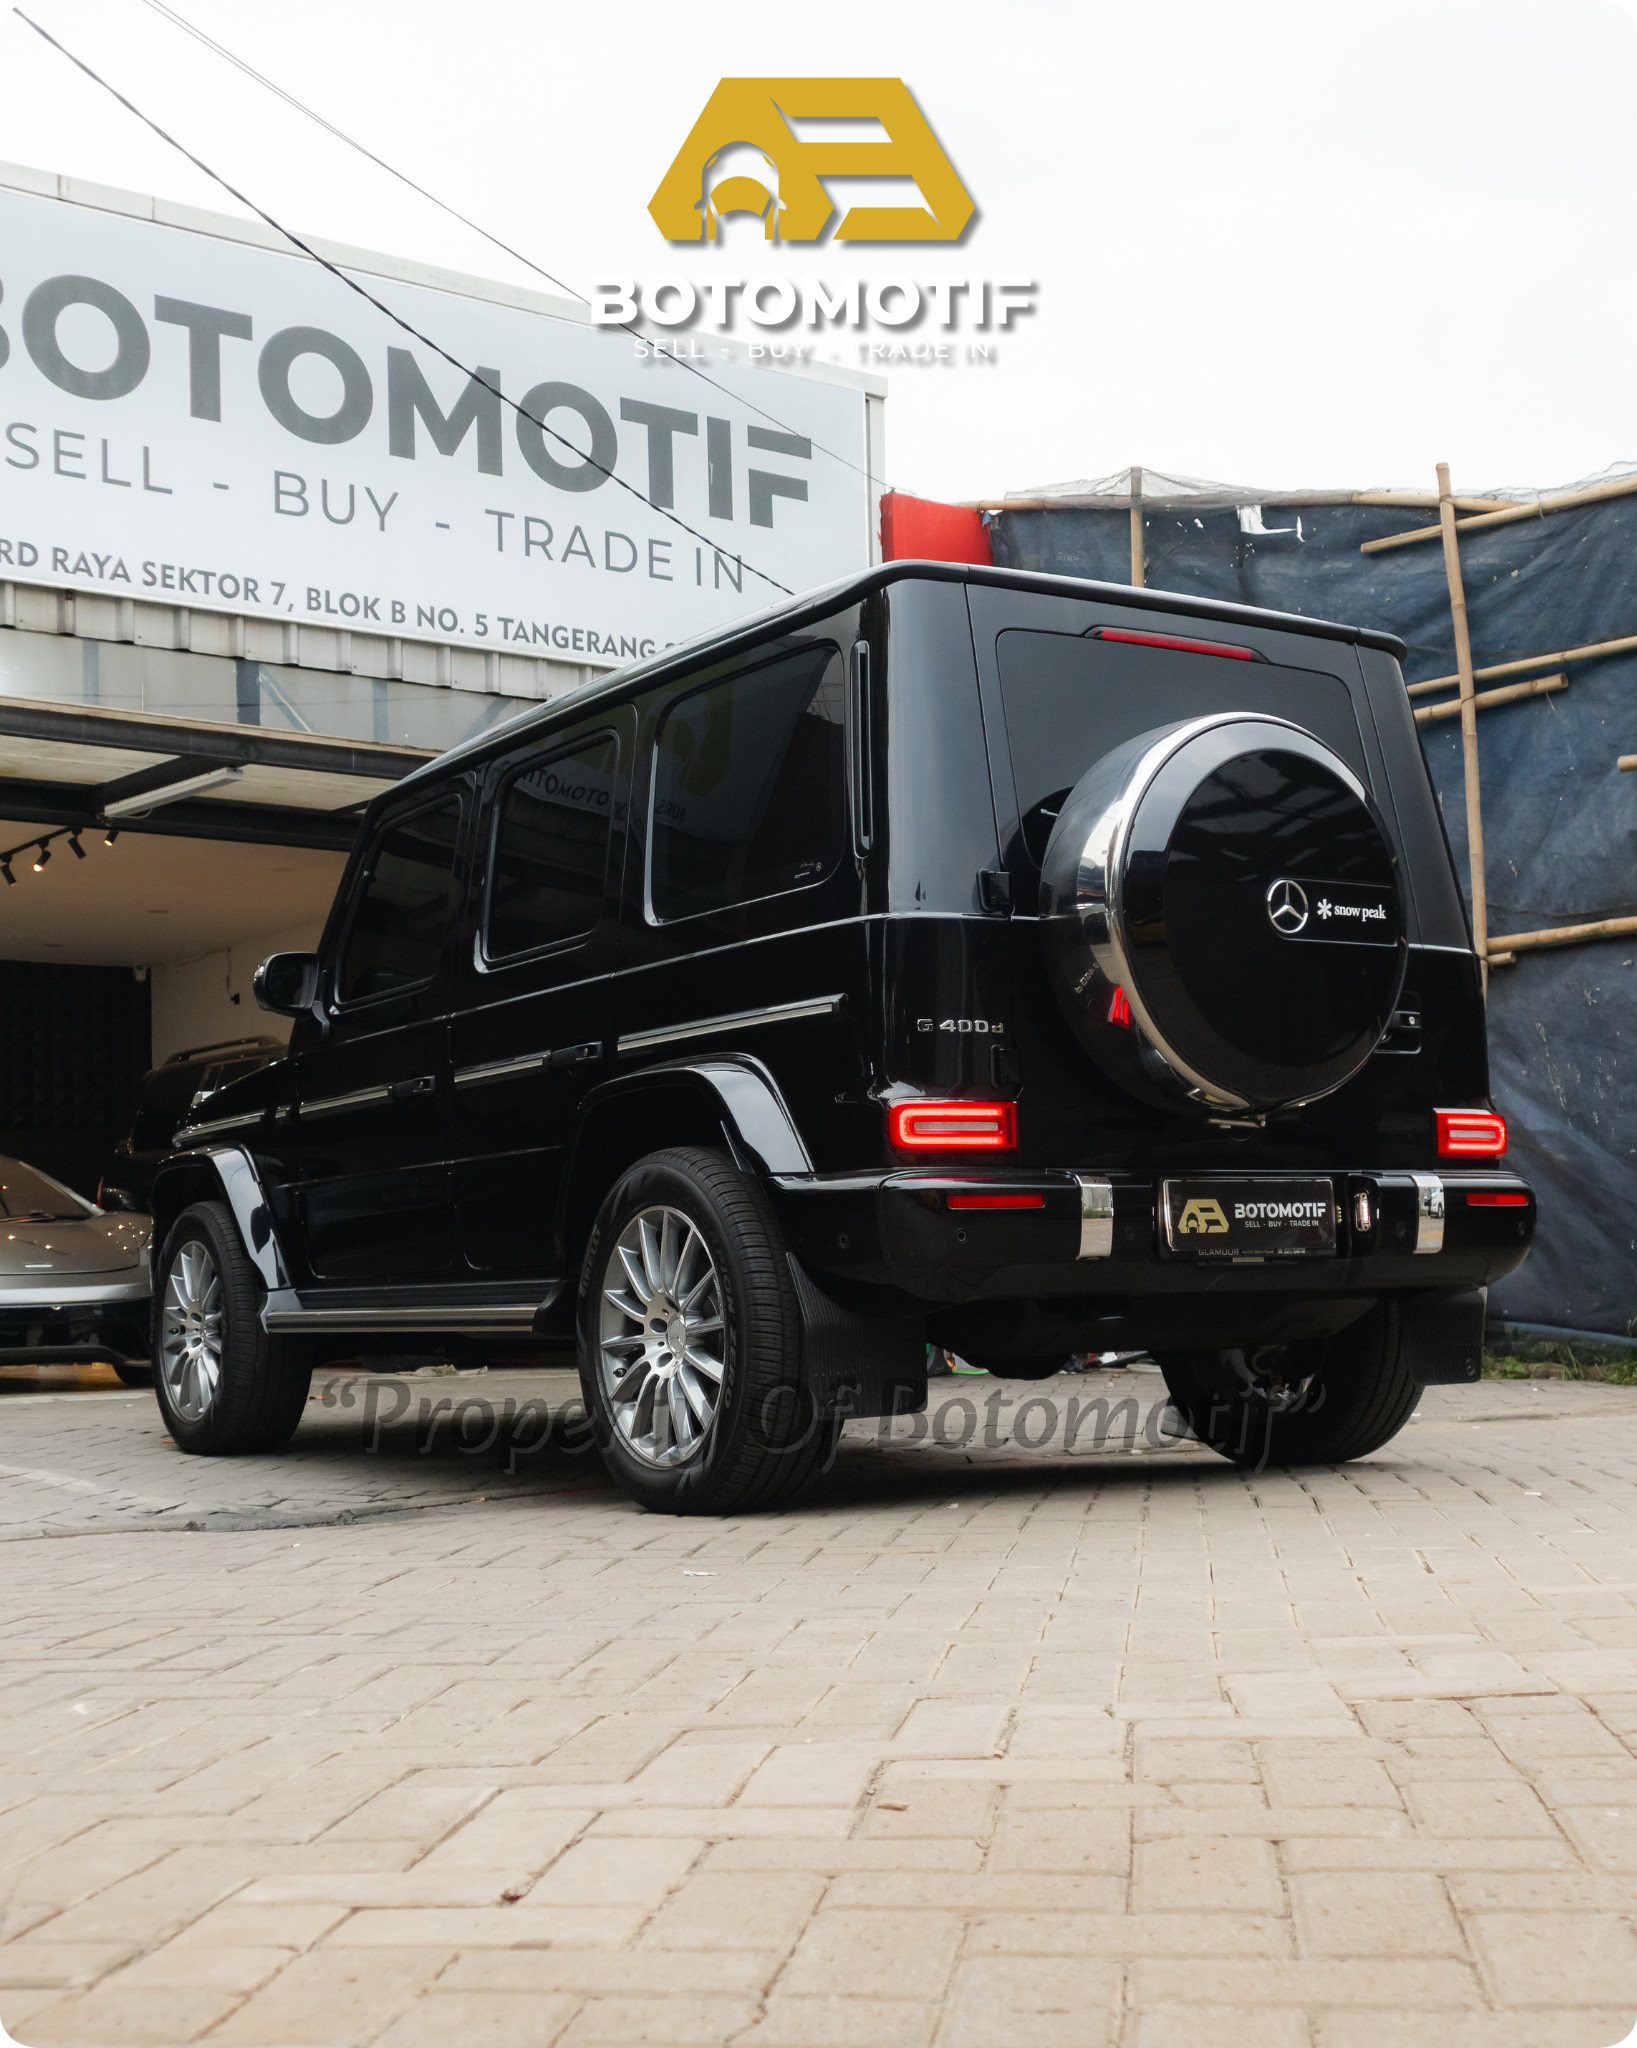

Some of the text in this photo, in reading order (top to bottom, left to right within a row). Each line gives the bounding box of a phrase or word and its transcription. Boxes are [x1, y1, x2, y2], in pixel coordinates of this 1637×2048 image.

[0, 274, 813, 528] OTOMOTIF
[5, 422, 173, 495] SELL
[274, 470, 399, 532] BUY
[485, 509, 674, 582] TRADE
[695, 546, 743, 594] IN
[52, 546, 132, 583] RAYA
[142, 561, 261, 604] SEKTOR
[271, 581, 294, 612] 7,
[306, 587, 381, 621] BLOK
[392, 599, 406, 624] B
[416, 604, 464, 636] NO.
[475, 613, 489, 637] 5
[497, 616, 656, 661] TANGERANG
[1334, 904, 1387, 922] snow peak
[917, 1018, 933, 1033] G
[1234, 1202, 1327, 1219] BOTOMOTIF
[1289, 1220, 1311, 1228] TRADE
[1311, 1219, 1319, 1227] IN
